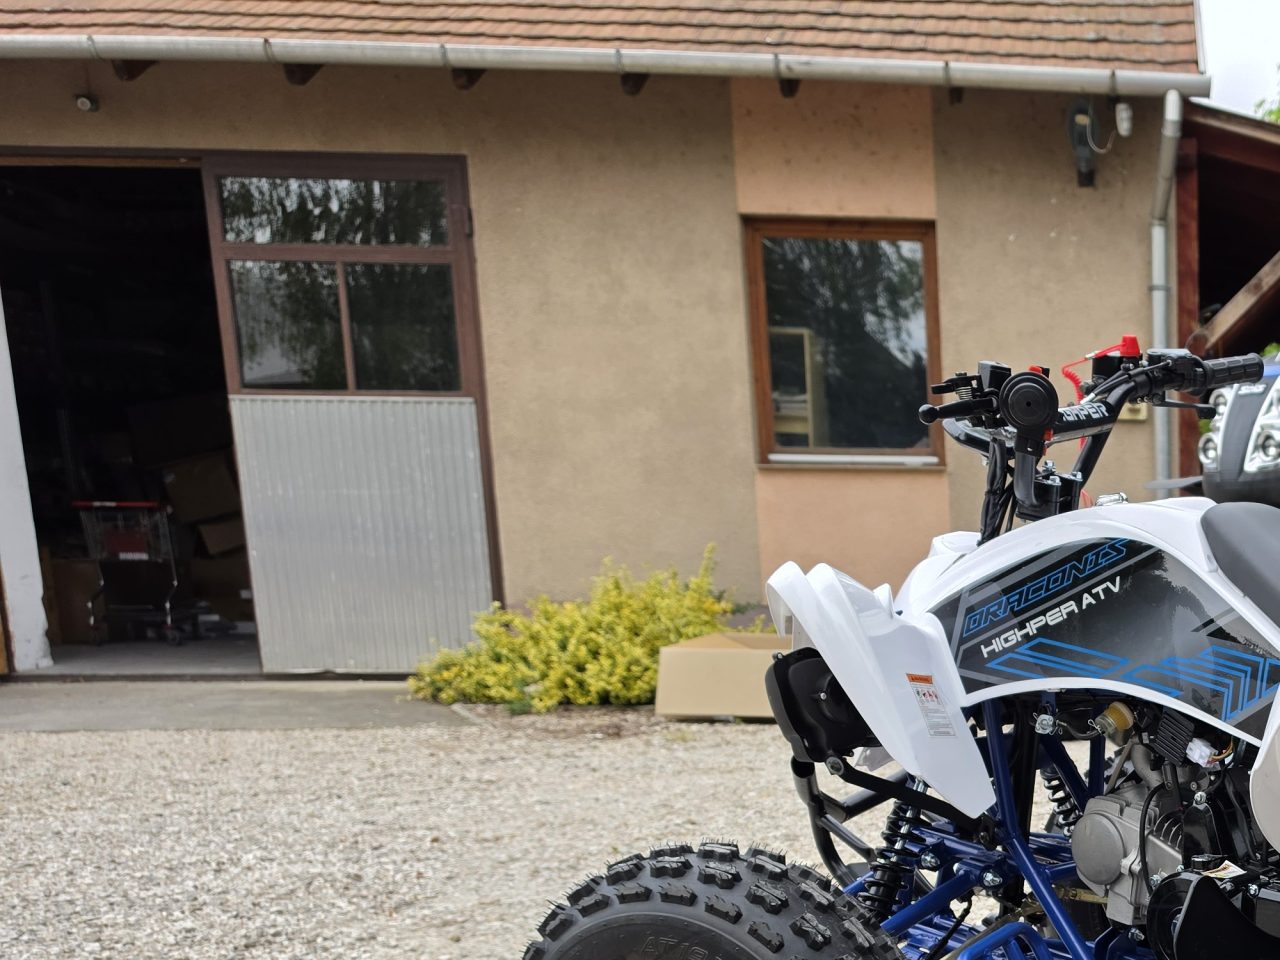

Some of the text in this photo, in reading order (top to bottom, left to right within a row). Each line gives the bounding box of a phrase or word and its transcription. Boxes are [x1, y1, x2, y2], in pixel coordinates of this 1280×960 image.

[963, 538, 1130, 638] DRACONIS
[981, 576, 1121, 658] HIGHPER ATV
